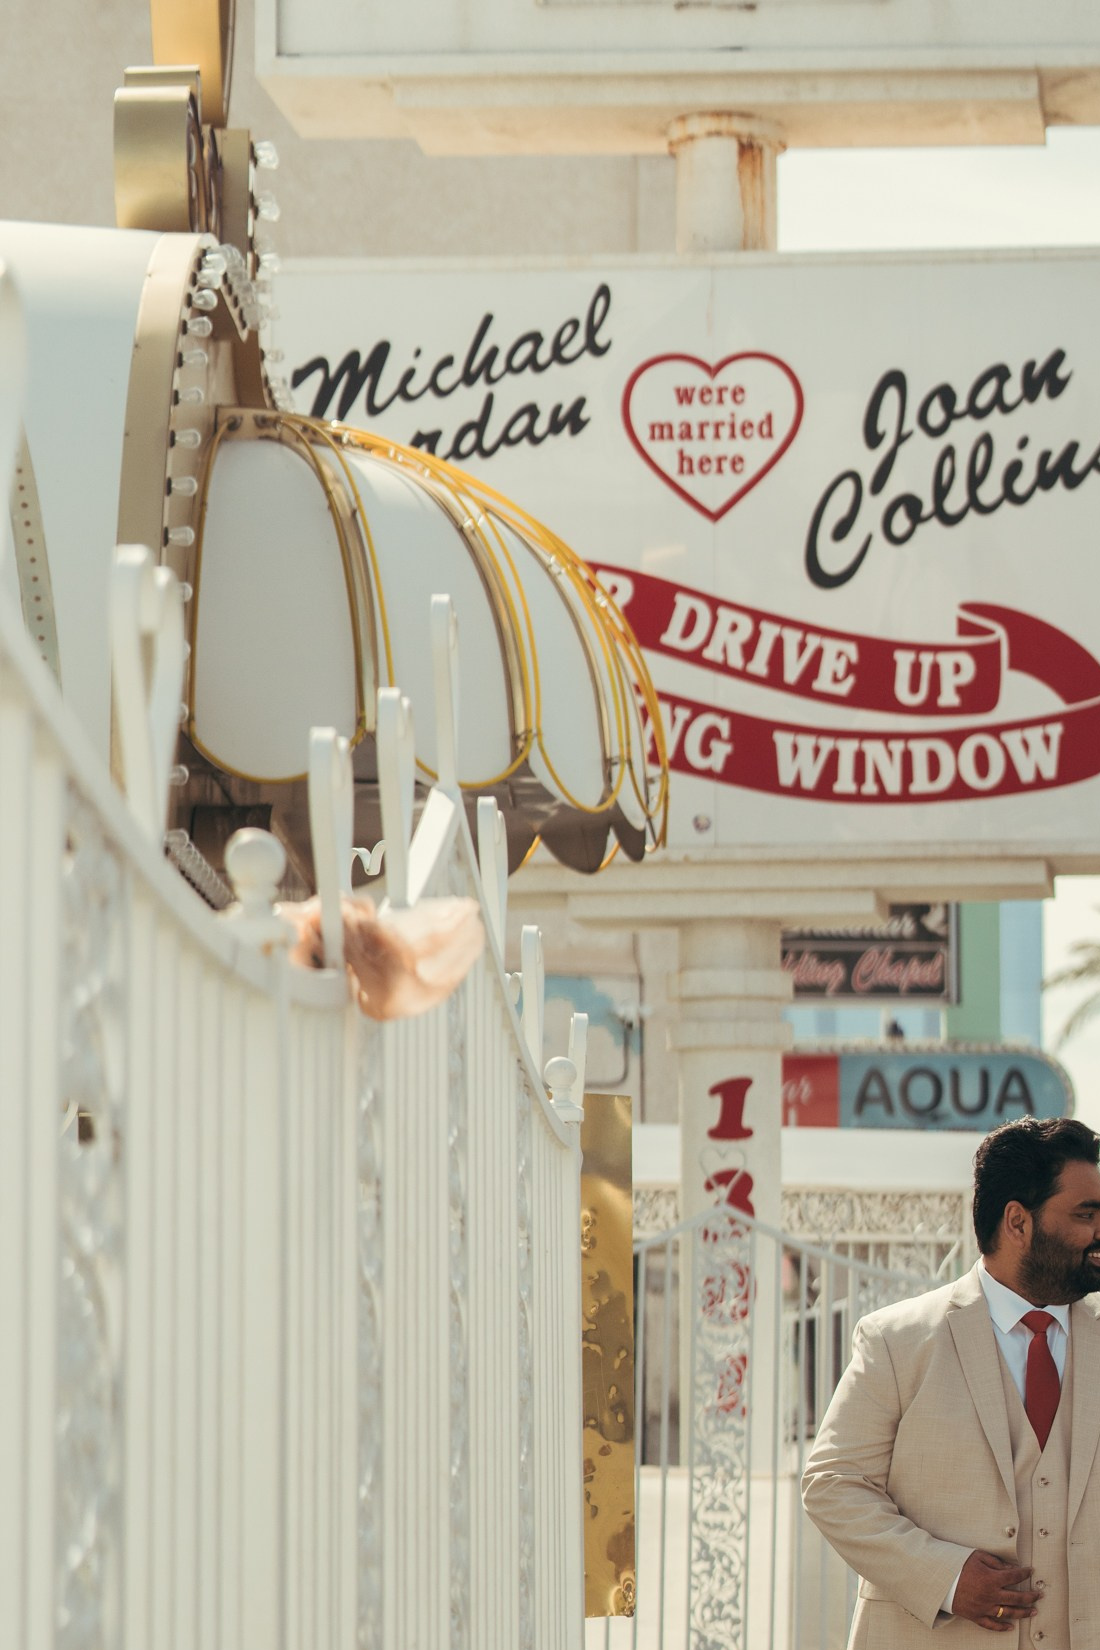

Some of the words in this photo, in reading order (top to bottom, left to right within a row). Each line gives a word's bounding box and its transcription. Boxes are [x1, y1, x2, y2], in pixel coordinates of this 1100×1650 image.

[291, 282, 612, 421] Michael
[410, 391, 591, 461] rdan
[648, 411, 775, 441] married
[673, 384, 747, 408] were
[863, 347, 1073, 494] Joan
[676, 447, 747, 475] here
[659, 592, 860, 698] DRIVE
[893, 650, 977, 708] UP
[772, 722, 1066, 796] WINDOW
[851, 945, 945, 996] Chapel
[854, 1066, 1036, 1121] AQUA
